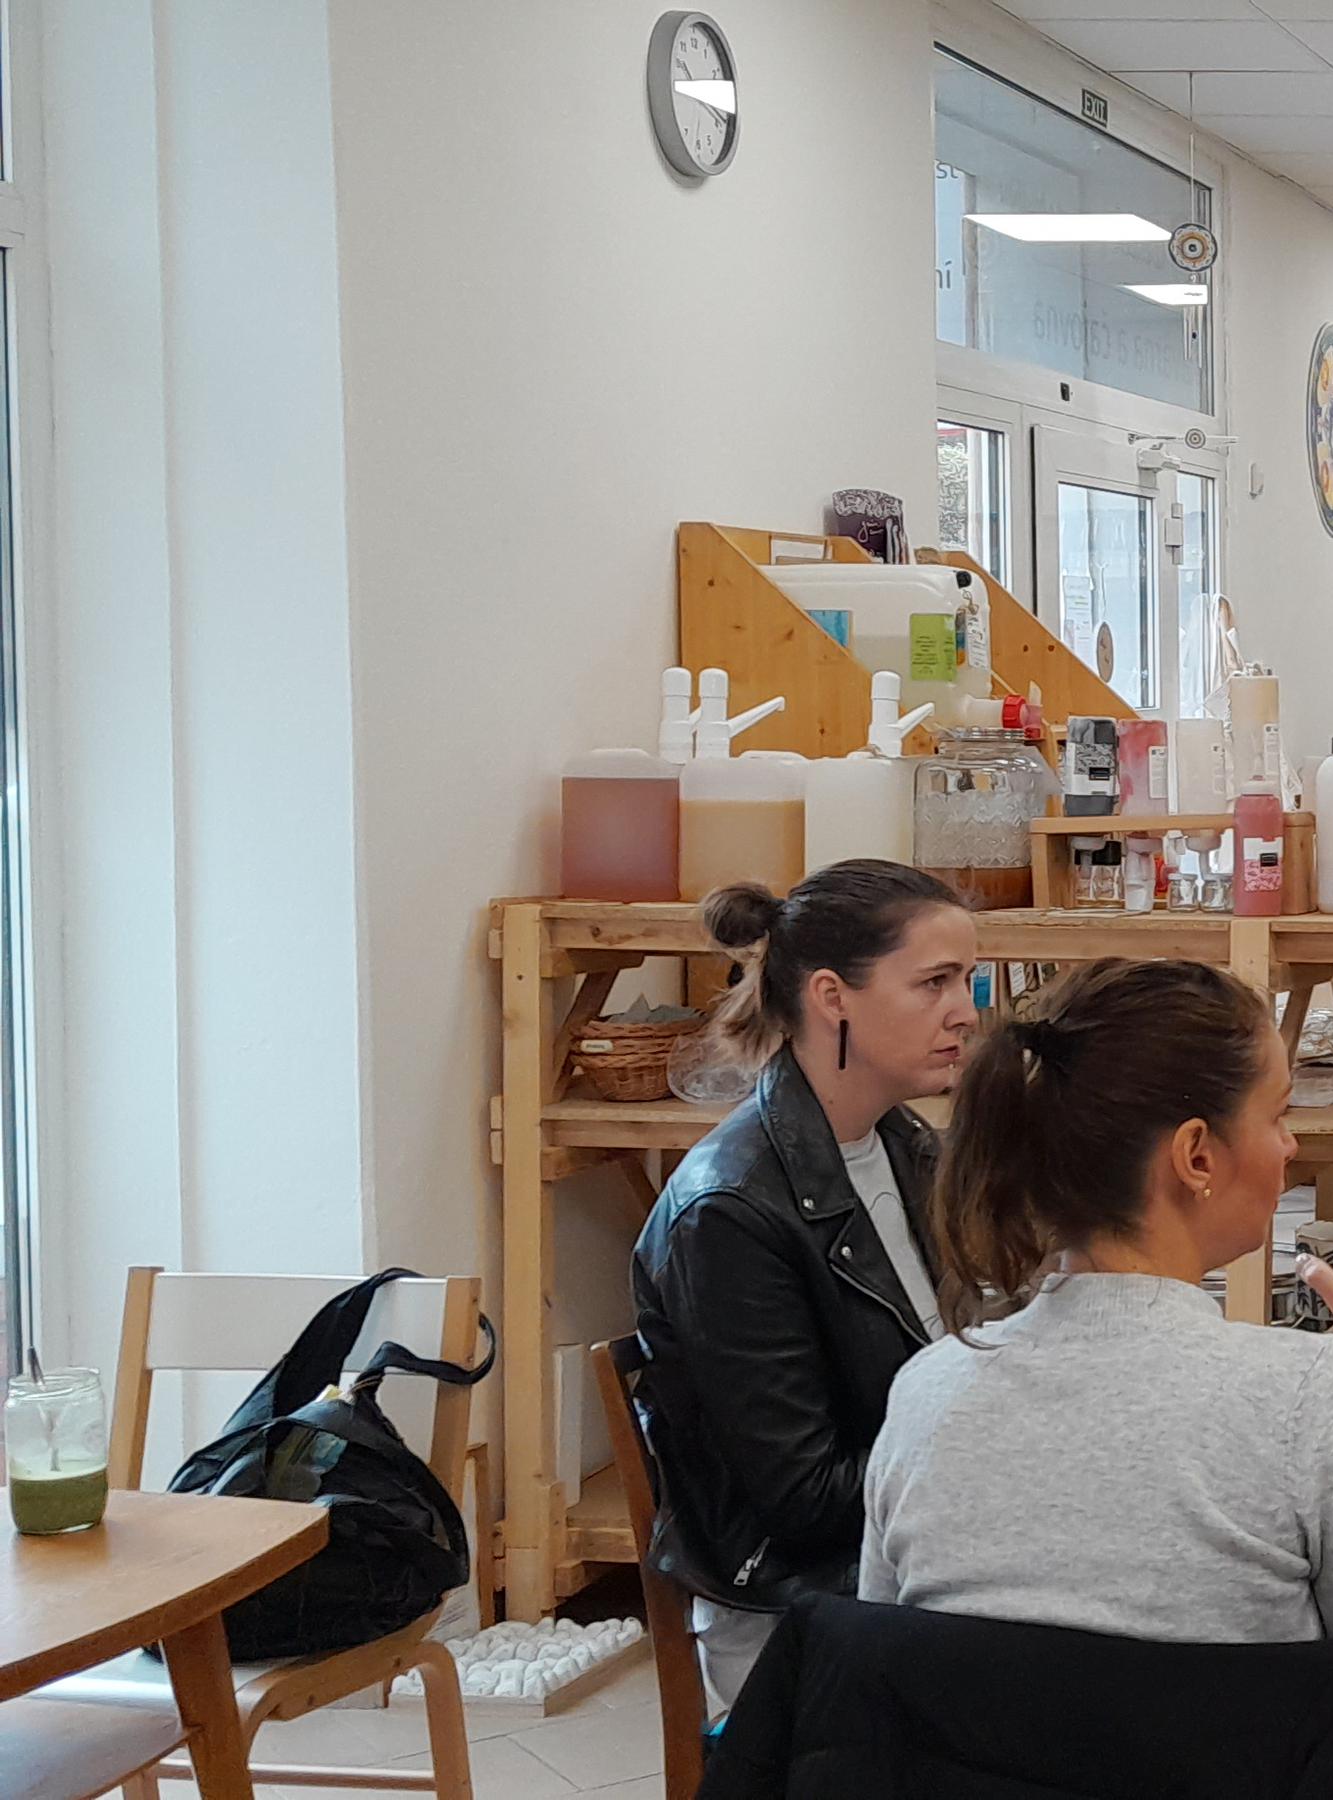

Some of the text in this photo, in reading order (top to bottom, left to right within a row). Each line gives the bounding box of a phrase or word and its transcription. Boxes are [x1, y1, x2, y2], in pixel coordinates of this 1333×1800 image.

[680, 40, 687, 53] 11
[690, 37, 698, 50] 12
[1085, 92, 1105, 122] EXIT
